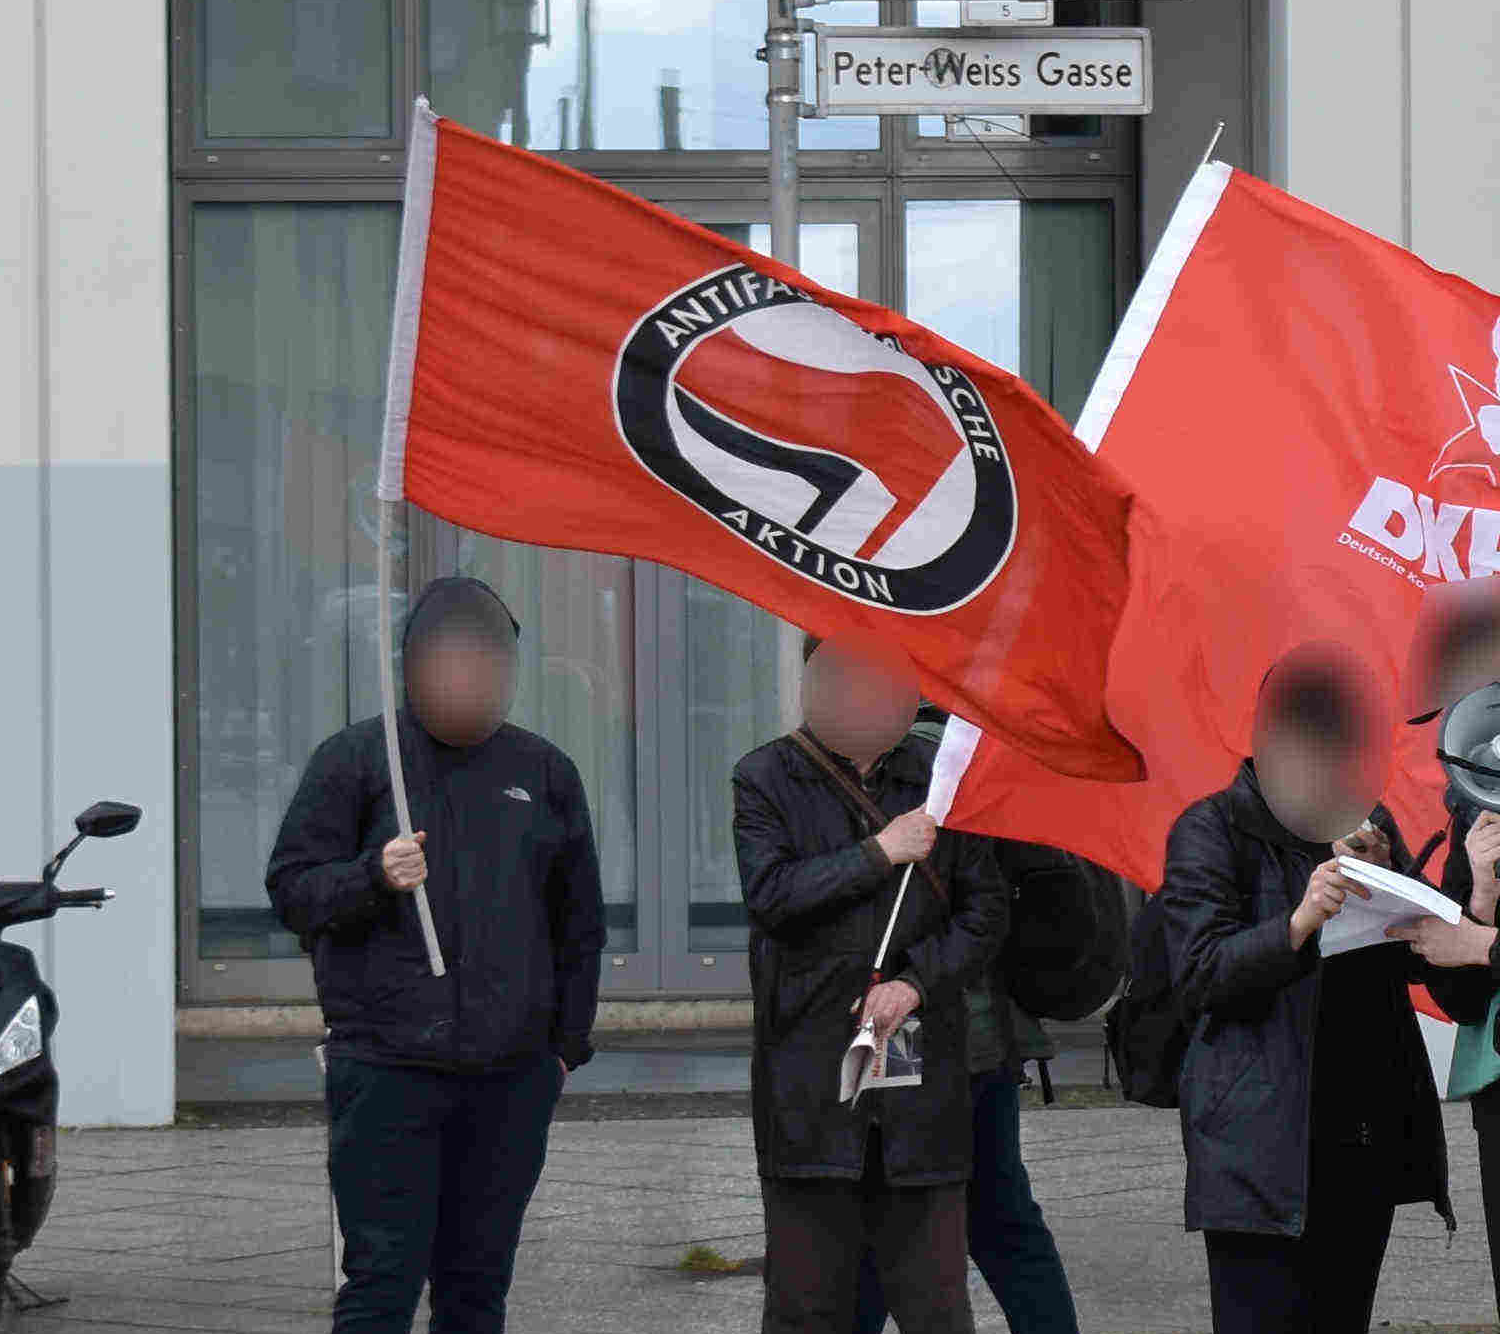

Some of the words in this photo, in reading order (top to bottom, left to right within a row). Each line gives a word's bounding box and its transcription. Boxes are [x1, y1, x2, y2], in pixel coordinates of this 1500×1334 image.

[1002, 4, 1011, 17] 5
[834, 51, 1020, 87] Peter-Weiss
[1036, 51, 1133, 87] Gasse
[655, 273, 1001, 464] ANTIFASCHE
[722, 508, 894, 603] AKTION
